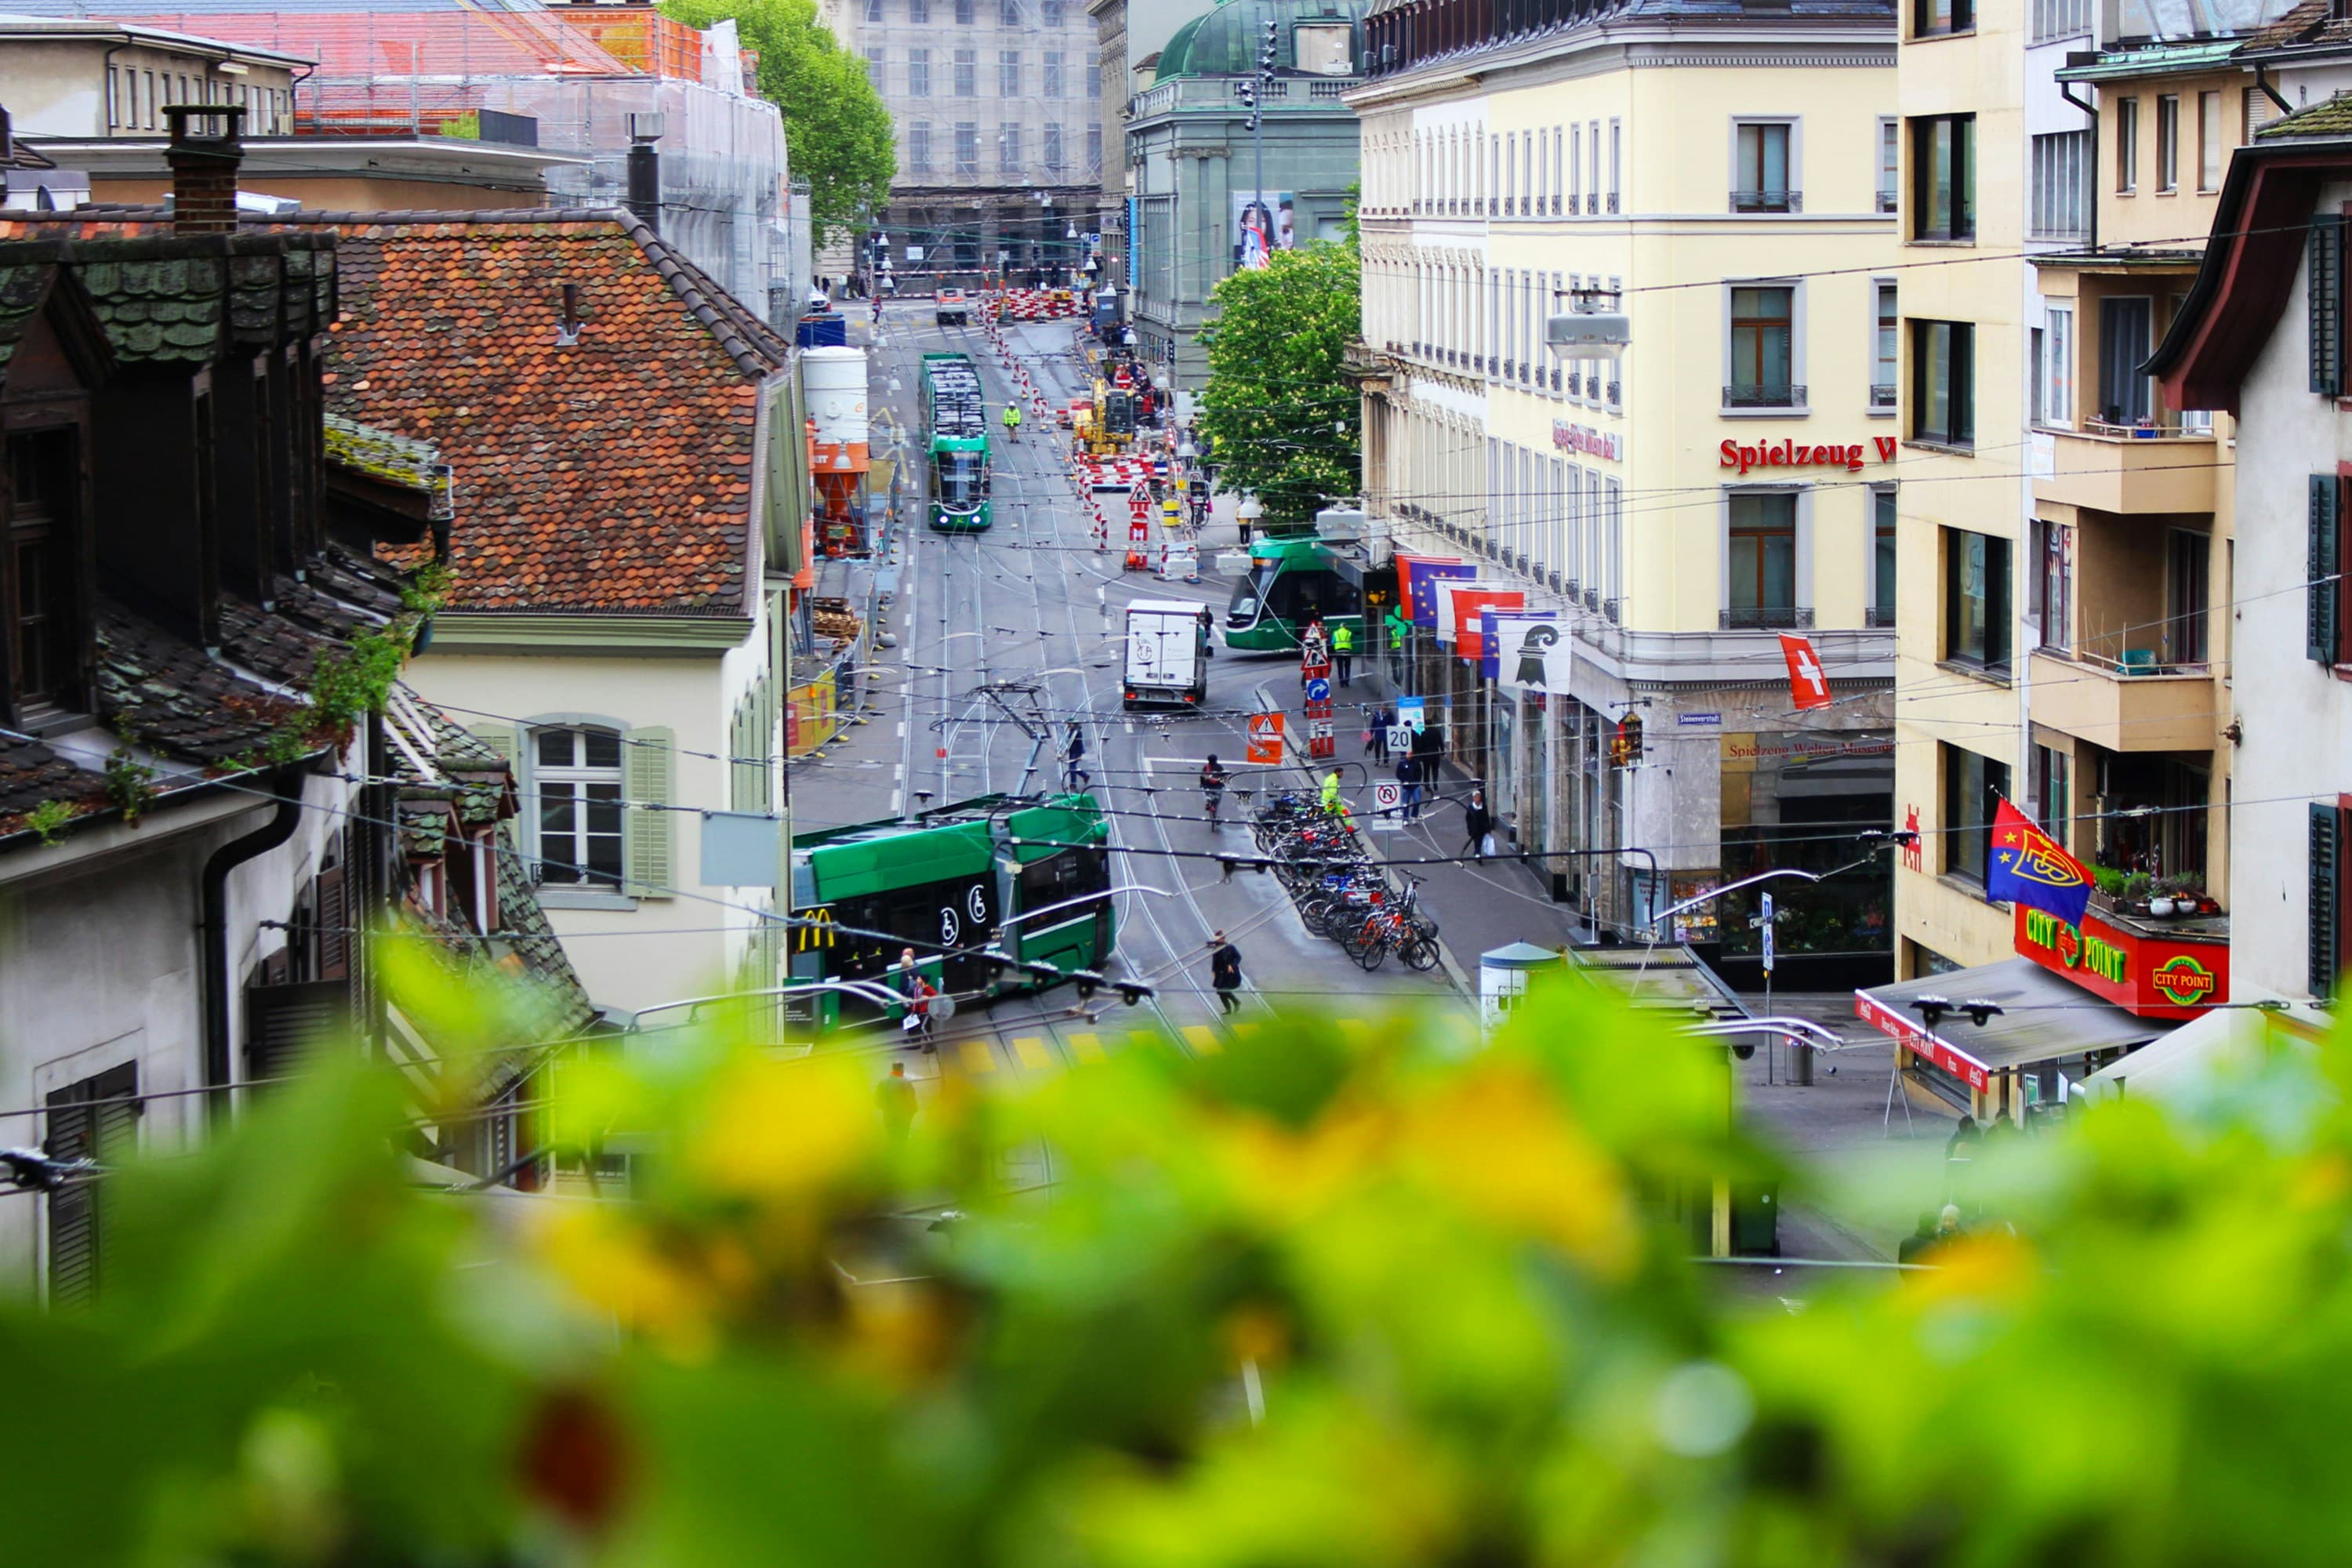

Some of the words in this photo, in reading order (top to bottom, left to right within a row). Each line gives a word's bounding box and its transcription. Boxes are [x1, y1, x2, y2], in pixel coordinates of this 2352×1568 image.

[1720, 438, 1864, 476] Spielzeug
[1390, 731, 1409, 747] 20
[2027, 909, 2057, 950] CITY
[2085, 935, 2126, 983] POINT
[2155, 973, 2178, 985] CITY
[2180, 975, 2210, 988] POINT
